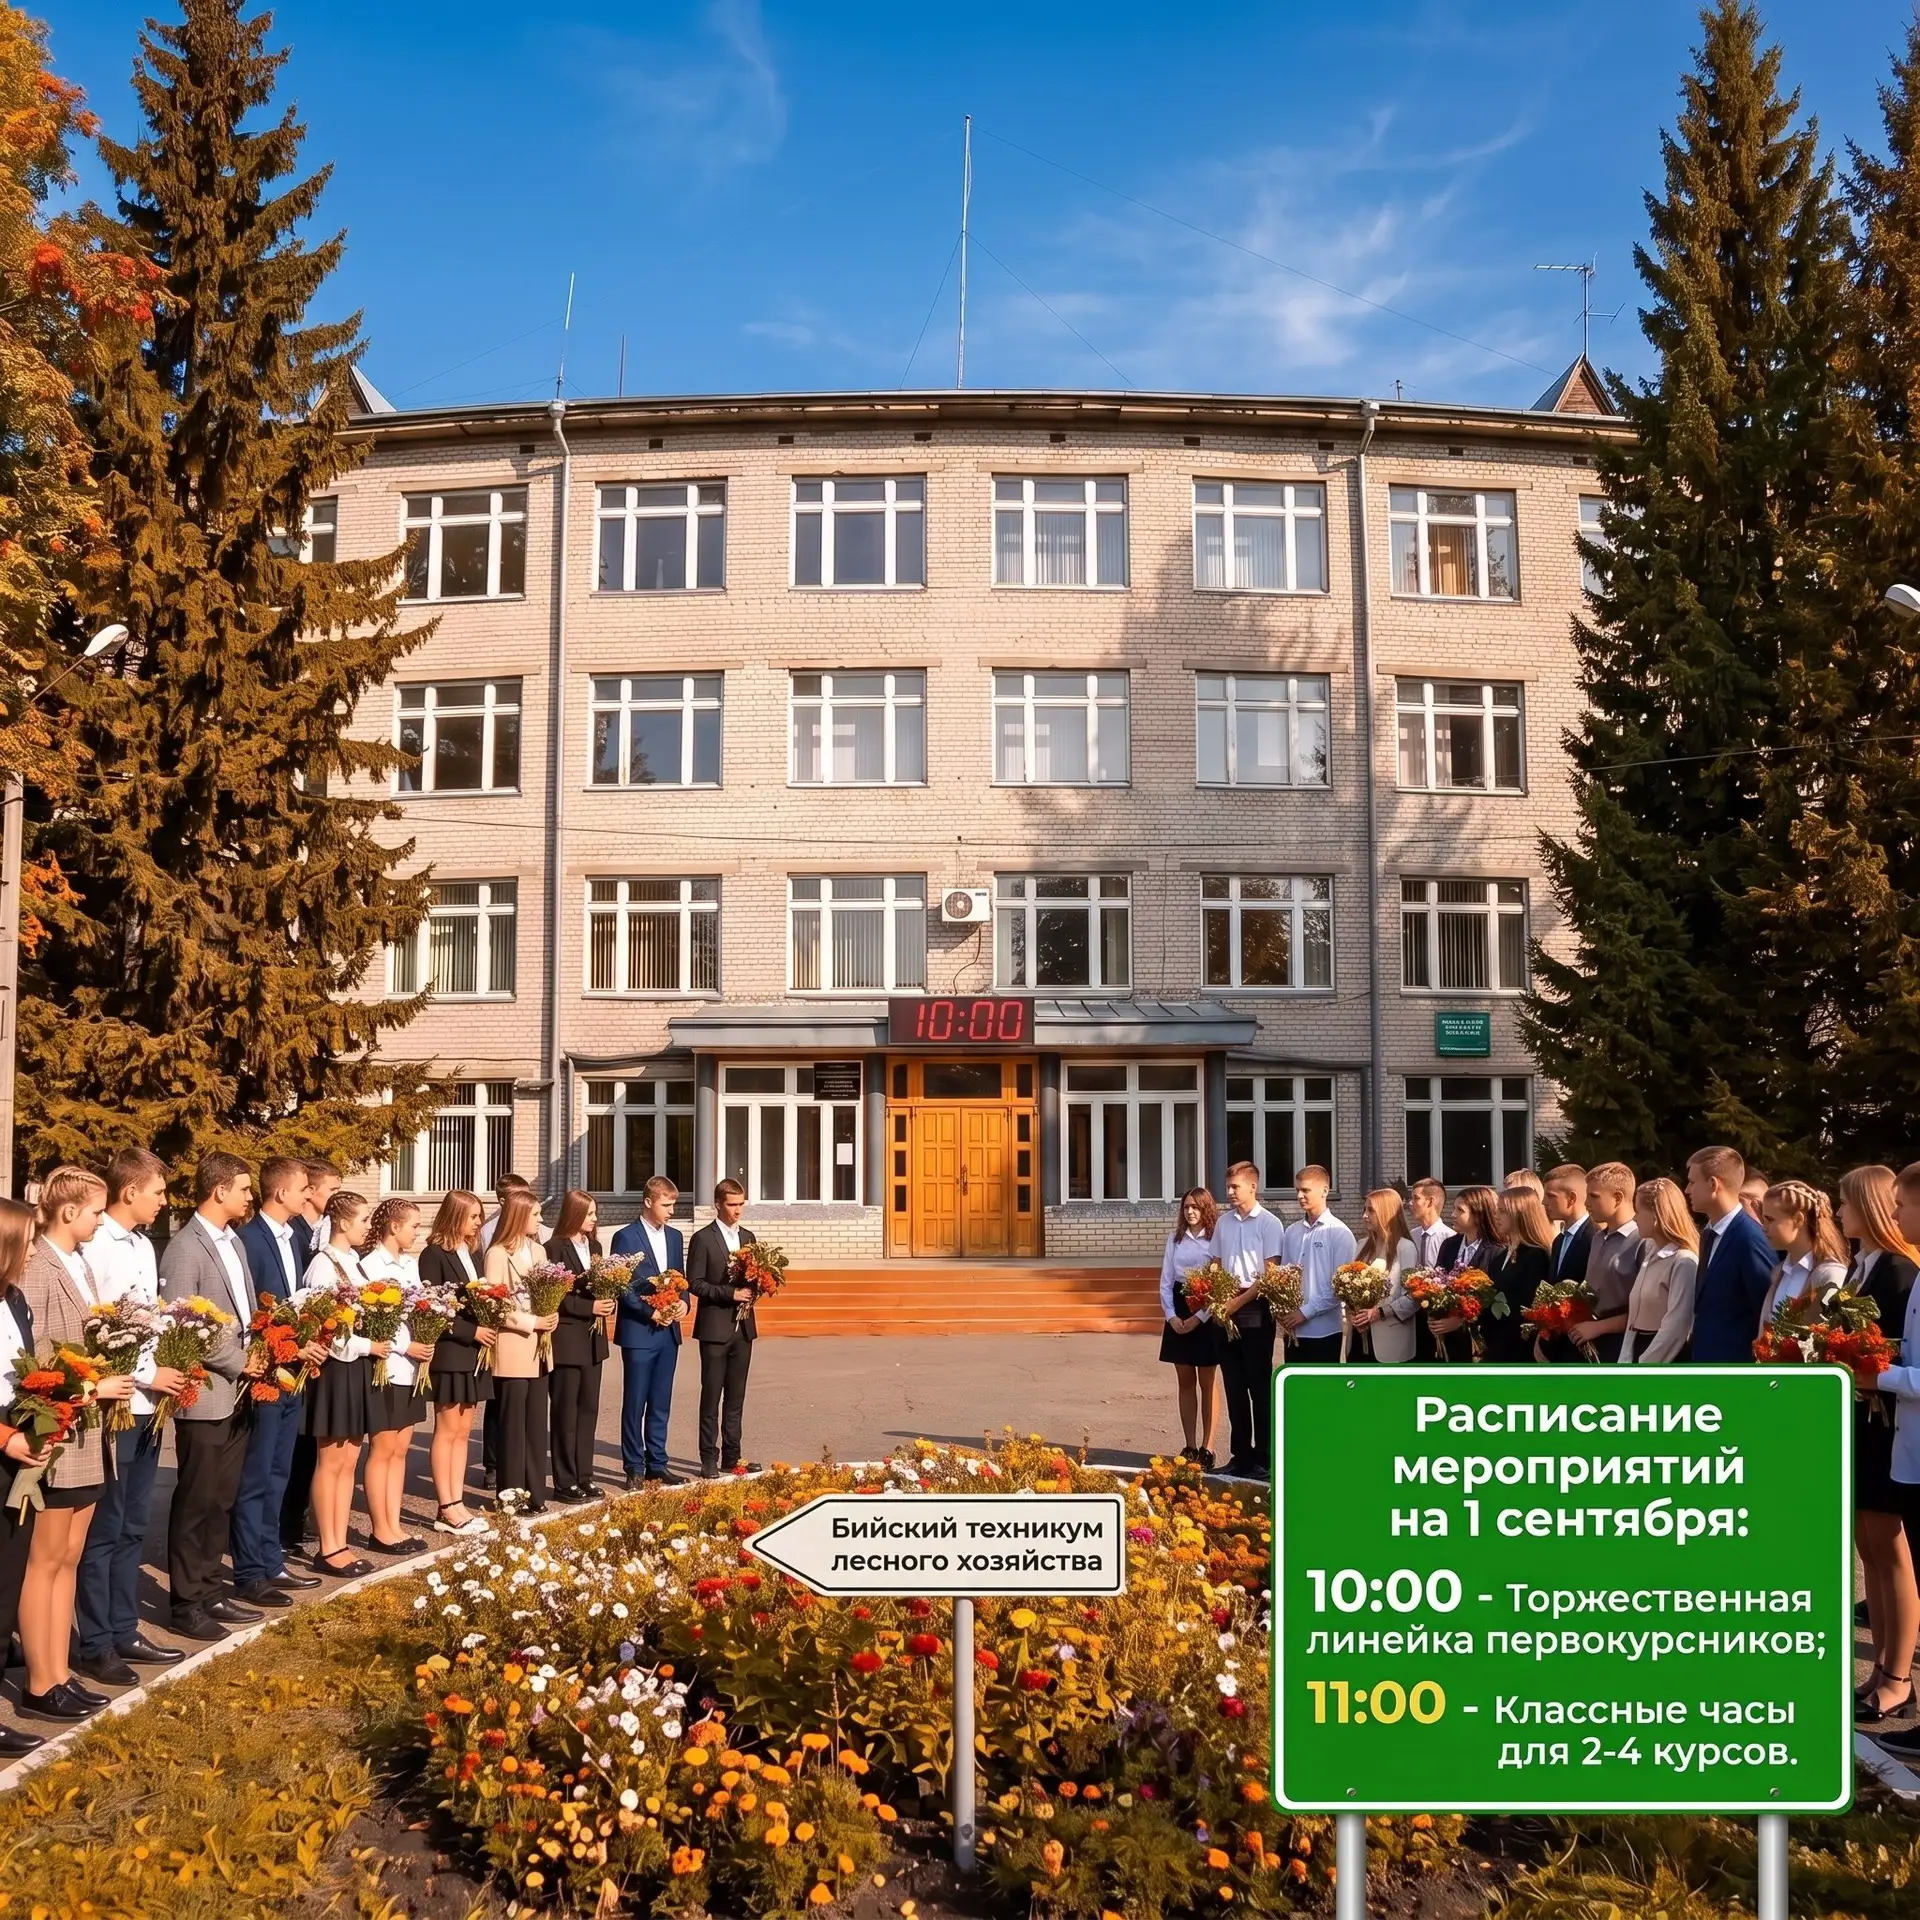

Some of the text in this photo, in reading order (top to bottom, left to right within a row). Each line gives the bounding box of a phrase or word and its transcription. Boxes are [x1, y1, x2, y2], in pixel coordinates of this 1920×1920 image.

[917, 1000, 1023, 1040] 10:00
[1416, 1396, 1723, 1433] Расписание
[1394, 1446, 1744, 1494] мероприятий
[832, 1516, 1103, 1544] Бийский техникум
[1391, 1496, 1749, 1546] на 1 сентября:
[831, 1548, 1102, 1571] лесного хозяйства
[1306, 1568, 1463, 1613] 10:00
[1505, 1583, 1811, 1619] Торжественная
[1306, 1623, 1826, 1661] линейка первокурсников;
[1306, 1680, 1446, 1725] 11:00
[1495, 1695, 1688, 1724] Классные
[1699, 1701, 1795, 1724] часы
[1497, 1736, 1798, 1773] для 2-4 курсов.
